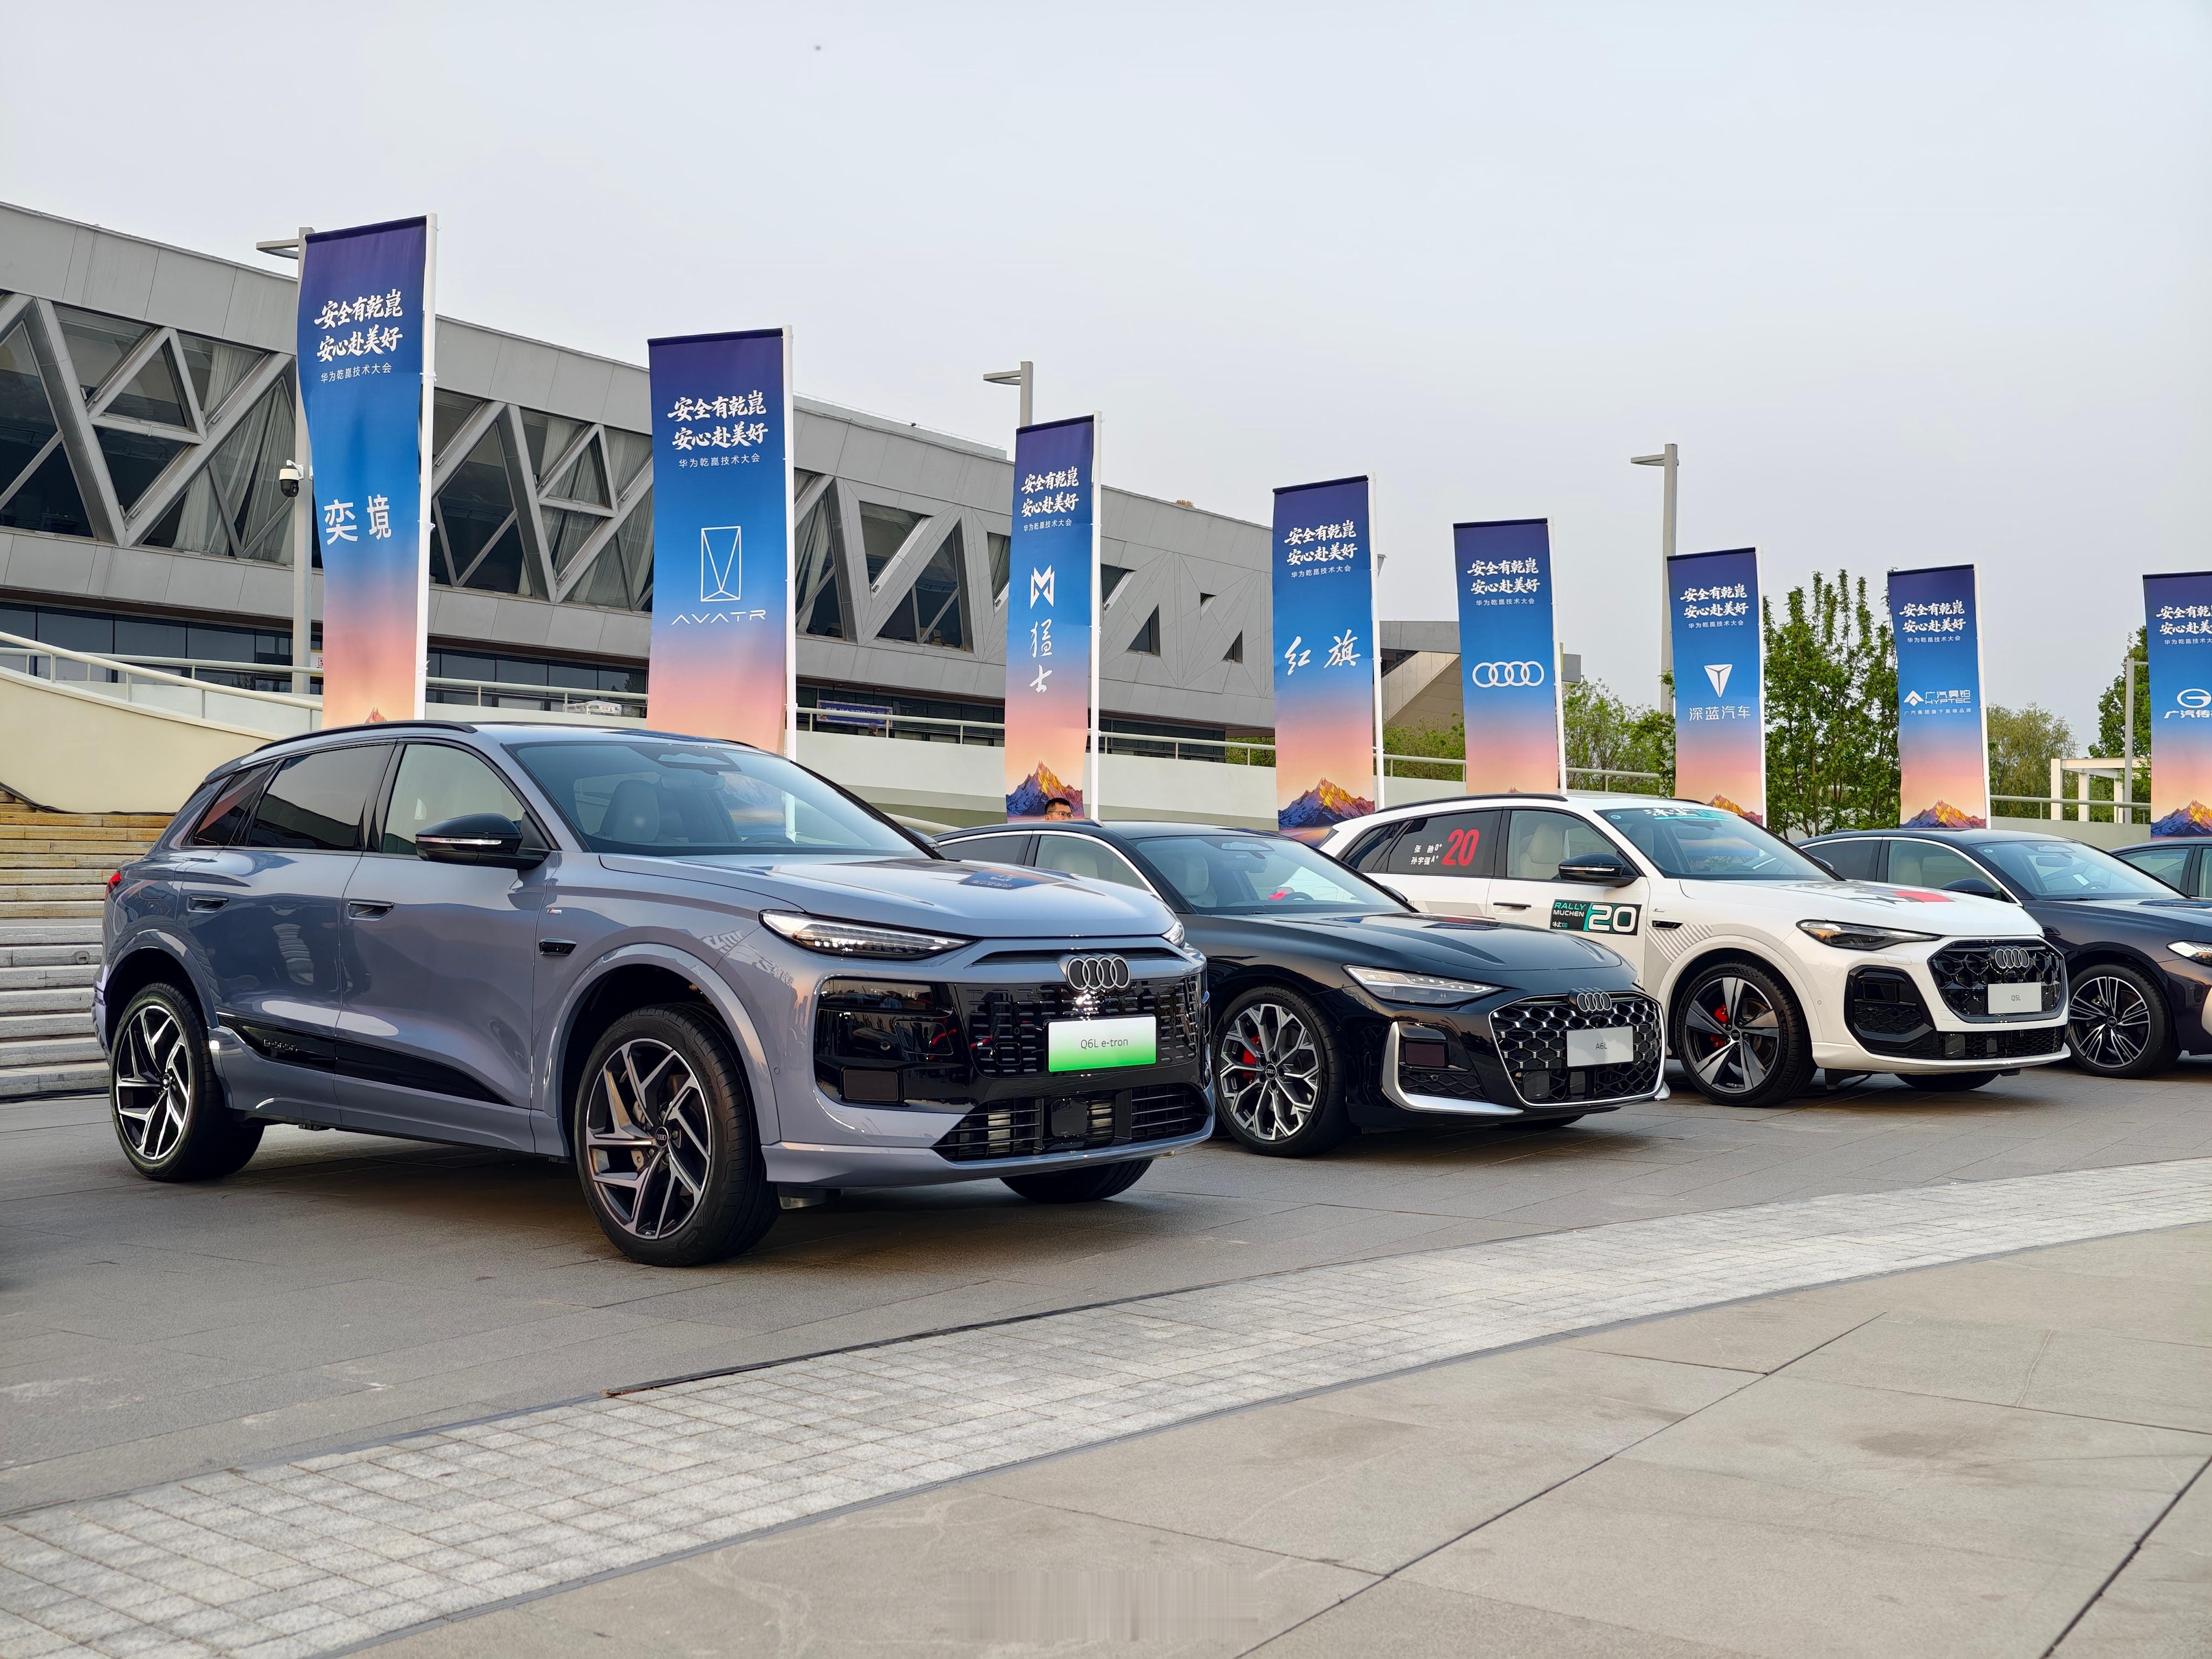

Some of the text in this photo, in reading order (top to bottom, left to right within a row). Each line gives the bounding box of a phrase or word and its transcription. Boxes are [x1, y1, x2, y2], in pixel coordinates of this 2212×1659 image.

[317, 324, 403, 362] 安心赴美好
[321, 362, 392, 383] 华为乾崑技术大会
[672, 421, 768, 450] 安心赴美好
[678, 454, 760, 468] 华为乾崑技术大会
[1021, 491, 1079, 518] 安心赴美好
[324, 494, 392, 545] 奕境
[1286, 542, 1358, 566] 安心赴美好
[1471, 576, 1541, 595] 安心赴美好
[671, 609, 766, 625] AVATR
[1683, 601, 1749, 619] 安心赴美好
[2155, 604, 2212, 620] 安全有乾
[1902, 617, 1966, 633] 安心赴美好
[2159, 619, 2212, 636] 安心赴美
[1029, 618, 1053, 693] 猛士
[1284, 629, 1361, 676] 红旗
[1689, 705, 1751, 721] 深蓝汽车
[2163, 710, 2212, 719] 广汽传
[1441, 828, 1480, 866] 20
[1553, 909, 1584, 918] MUCHEN
[1554, 902, 1587, 911] RALLY
[1588, 903, 1637, 933] 20
[1080, 1037, 1129, 1050] Q6L e-tron
